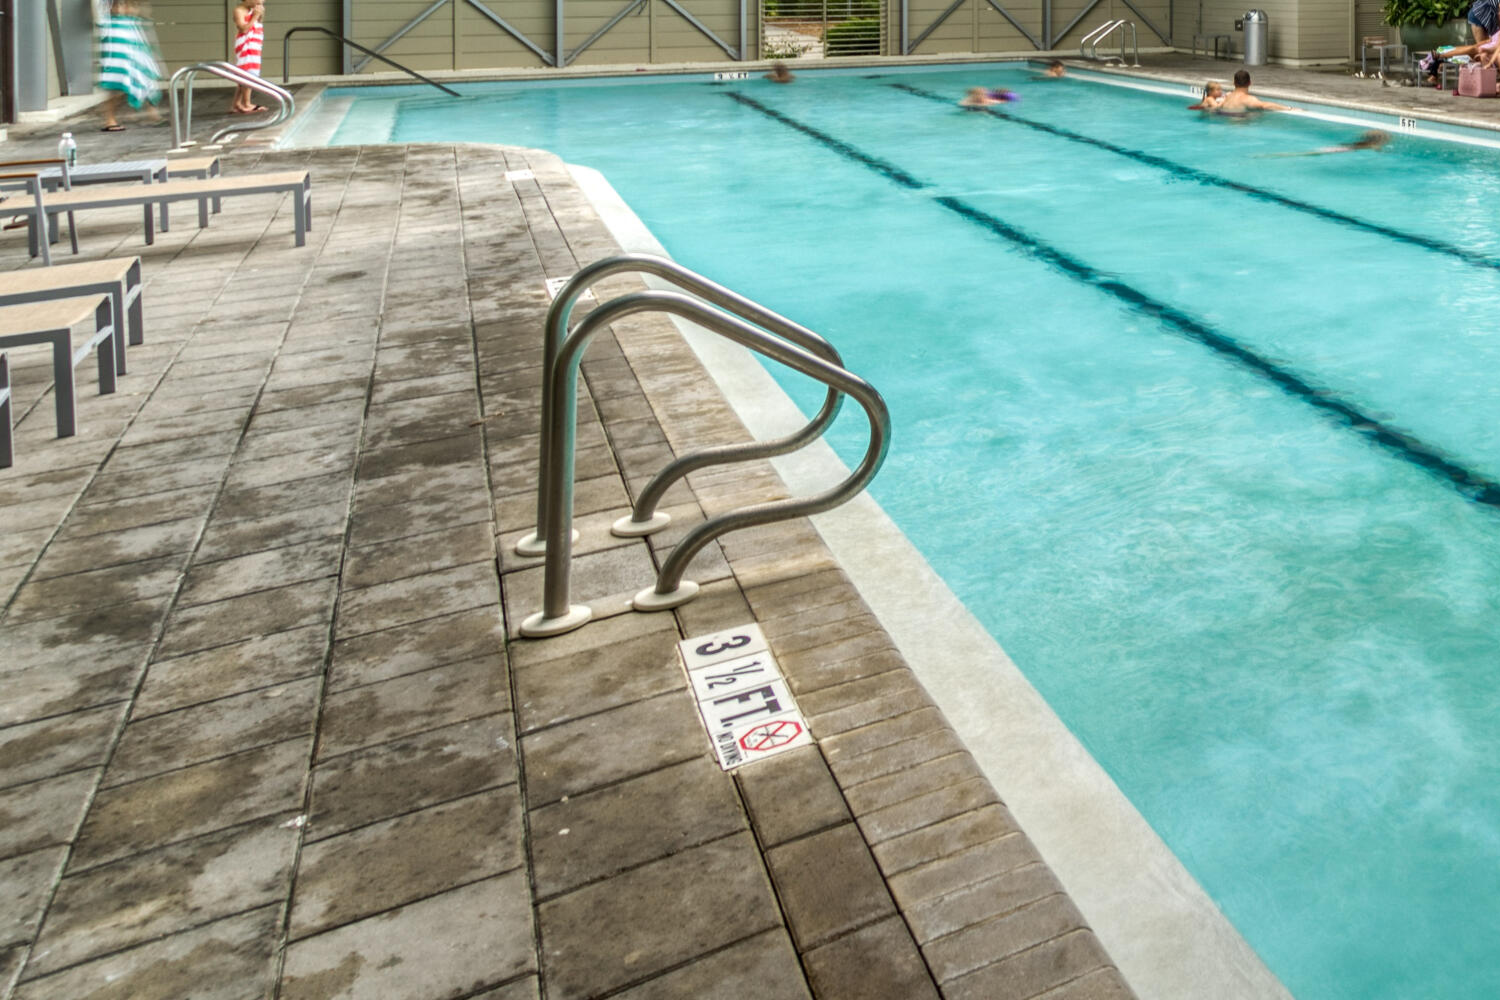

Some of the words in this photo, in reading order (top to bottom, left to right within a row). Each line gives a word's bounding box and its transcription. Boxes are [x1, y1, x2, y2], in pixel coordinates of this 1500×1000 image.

[1408, 119, 1415, 128] FT
[696, 635, 751, 656] 3
[713, 685, 782, 728] FT.
[716, 731, 734, 743] NO
[720, 741, 743, 766] DIVING
